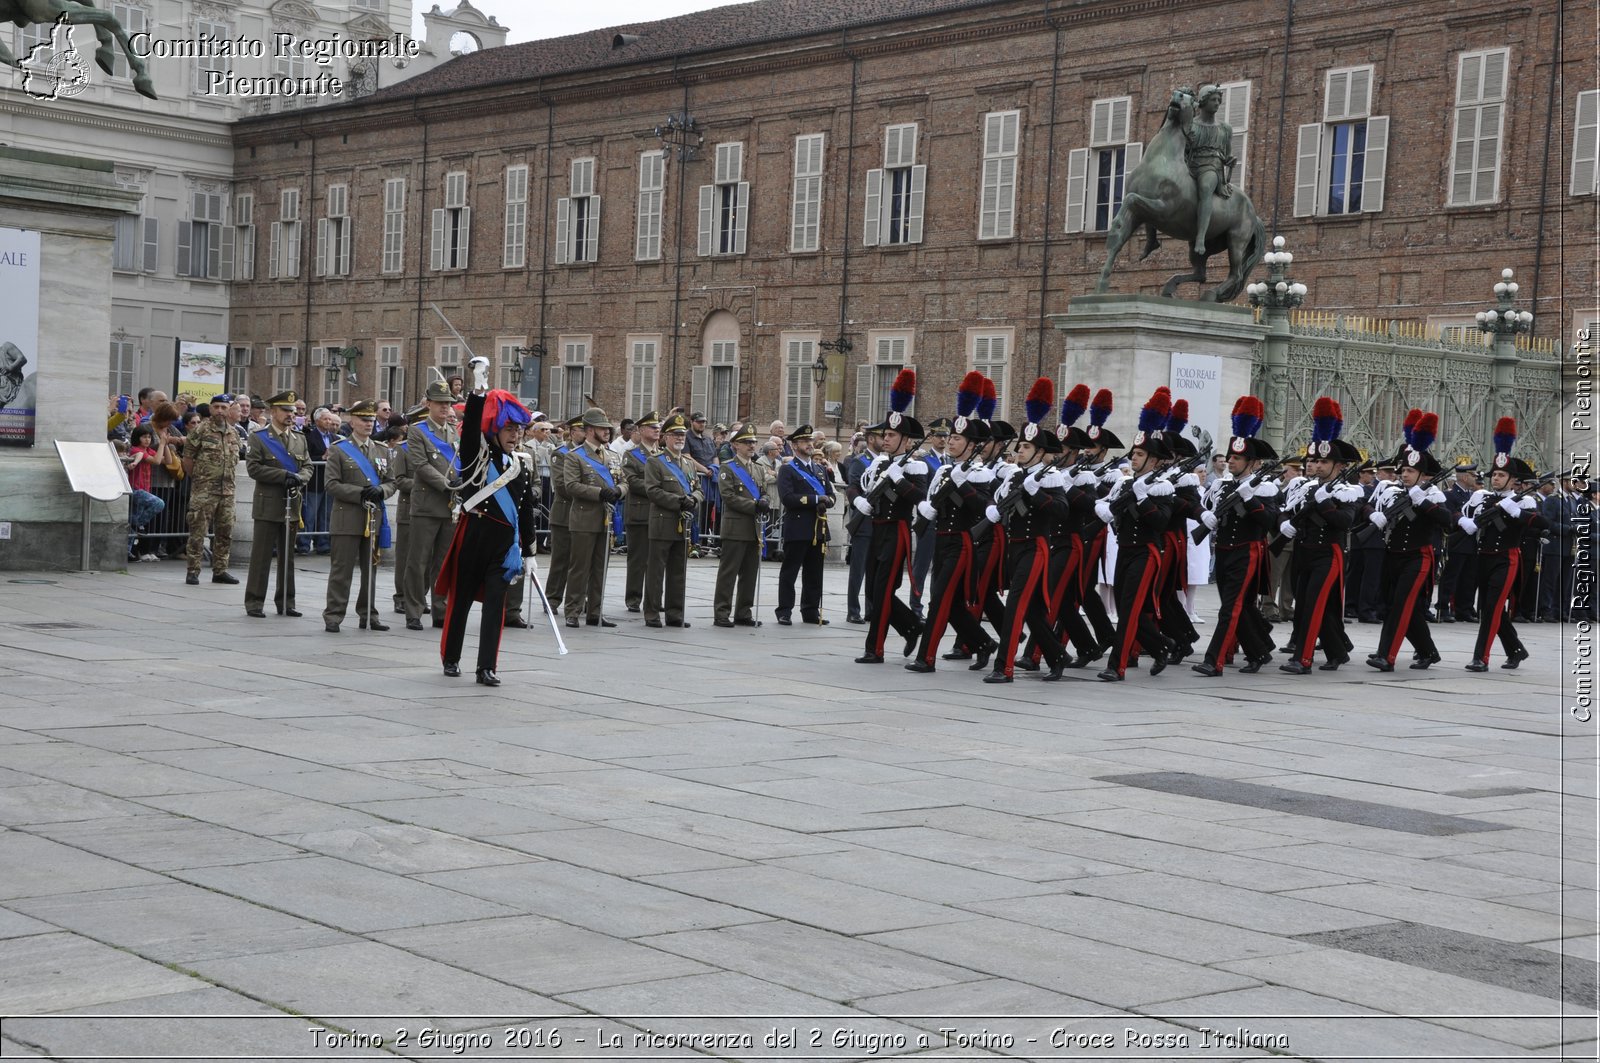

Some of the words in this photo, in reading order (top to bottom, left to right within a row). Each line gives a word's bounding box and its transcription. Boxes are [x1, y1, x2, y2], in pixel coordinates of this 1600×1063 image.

[0, 251, 27, 266] ALE
[1176, 368, 1196, 378] POLO
[1196, 369, 1216, 379] REALE
[1176, 379, 1205, 390] TORINO
